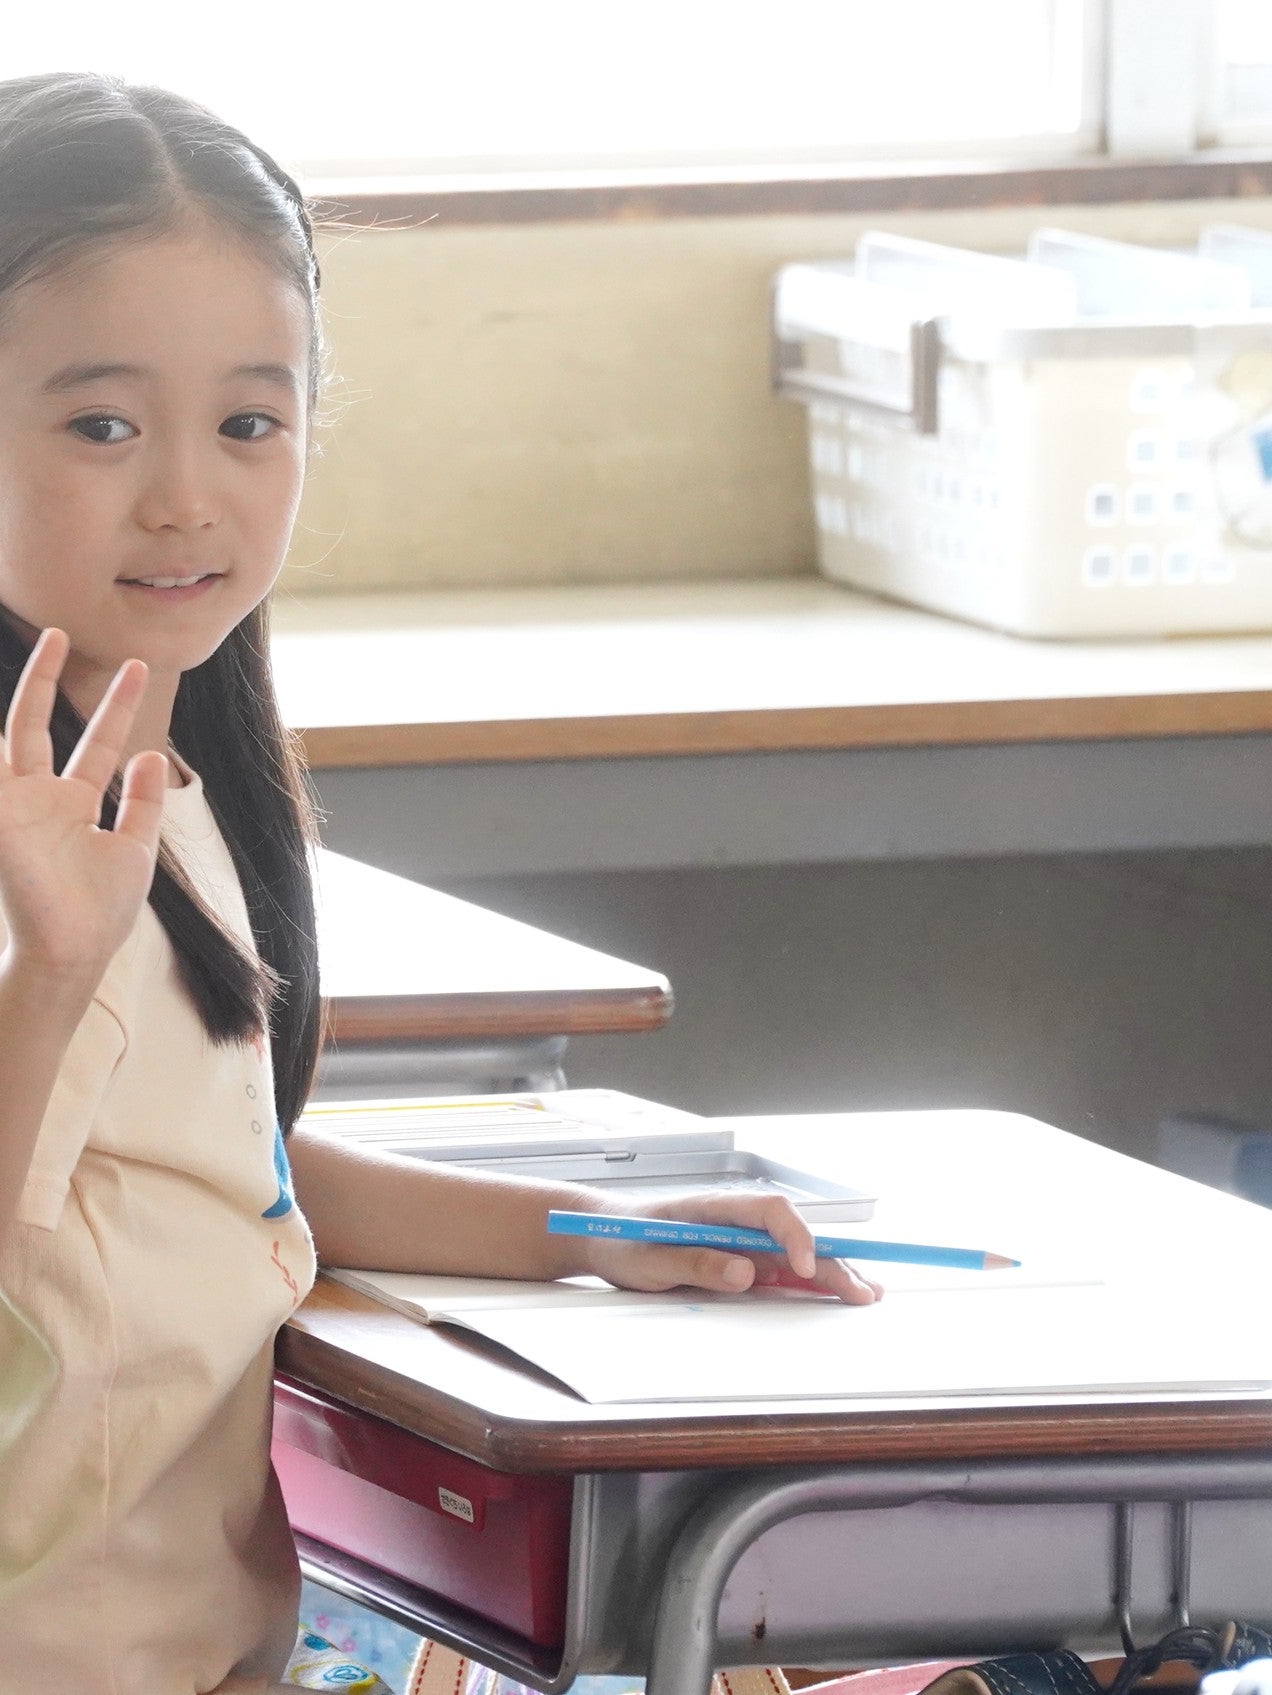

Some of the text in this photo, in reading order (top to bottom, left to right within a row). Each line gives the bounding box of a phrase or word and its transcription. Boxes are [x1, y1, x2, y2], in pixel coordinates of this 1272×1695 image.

[644, 1228, 773, 1248] COLORED PENCIL FOR DRAWING
